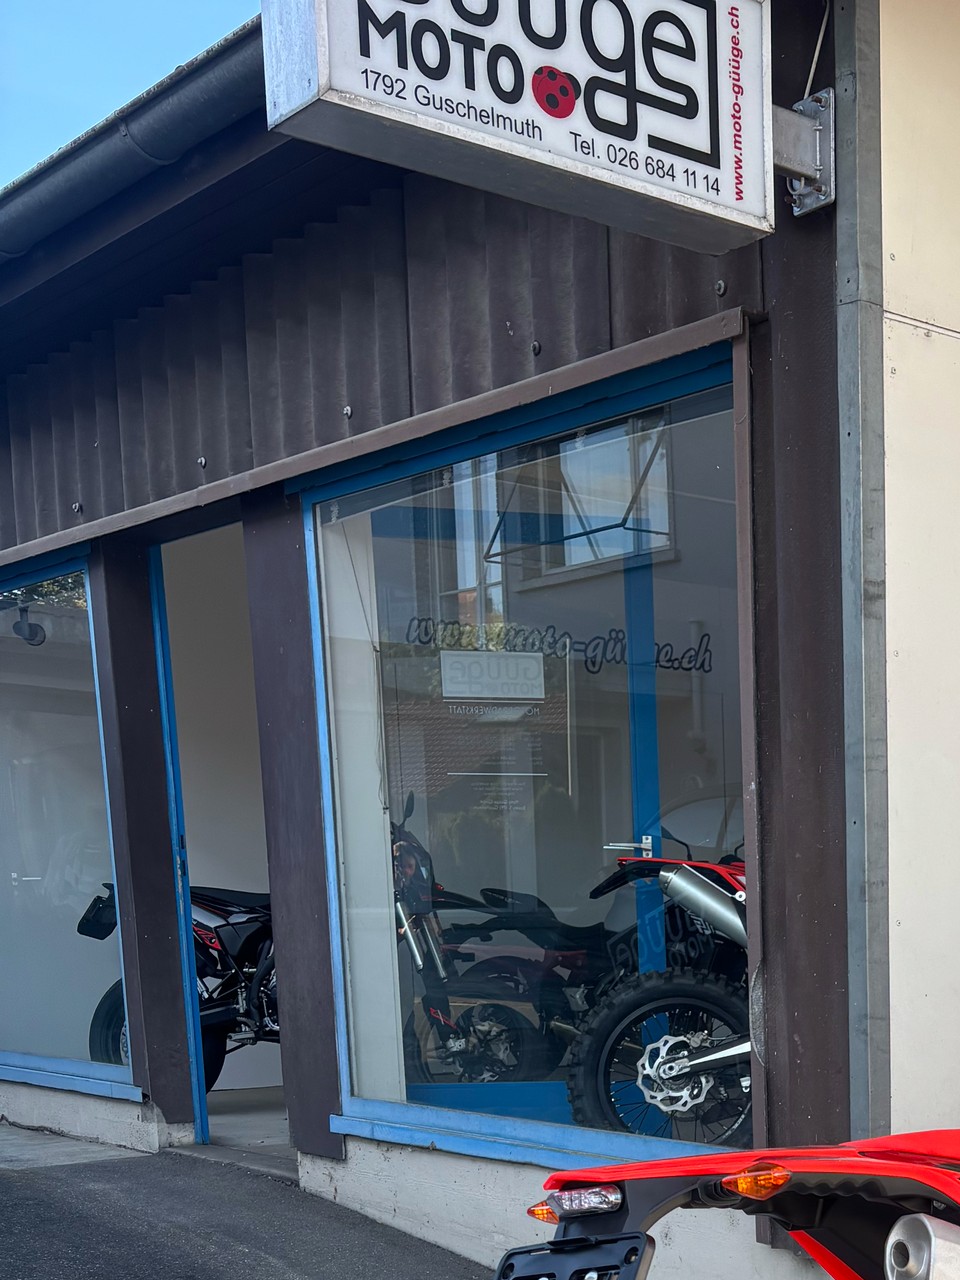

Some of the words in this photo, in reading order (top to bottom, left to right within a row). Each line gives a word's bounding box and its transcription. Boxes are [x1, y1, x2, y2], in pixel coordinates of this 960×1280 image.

[357, 0, 525, 104] MOTO
[360, 68, 407, 100] 1792
[414, 84, 542, 141] Guschelmuth
[727, 6, 744, 202] www.moto-güüge.ch
[569, 131, 600, 159] Tel.
[607, 143, 639, 171] 026
[645, 155, 676, 182] 684
[683, 168, 697, 189] 11
[703, 174, 721, 196] 14
